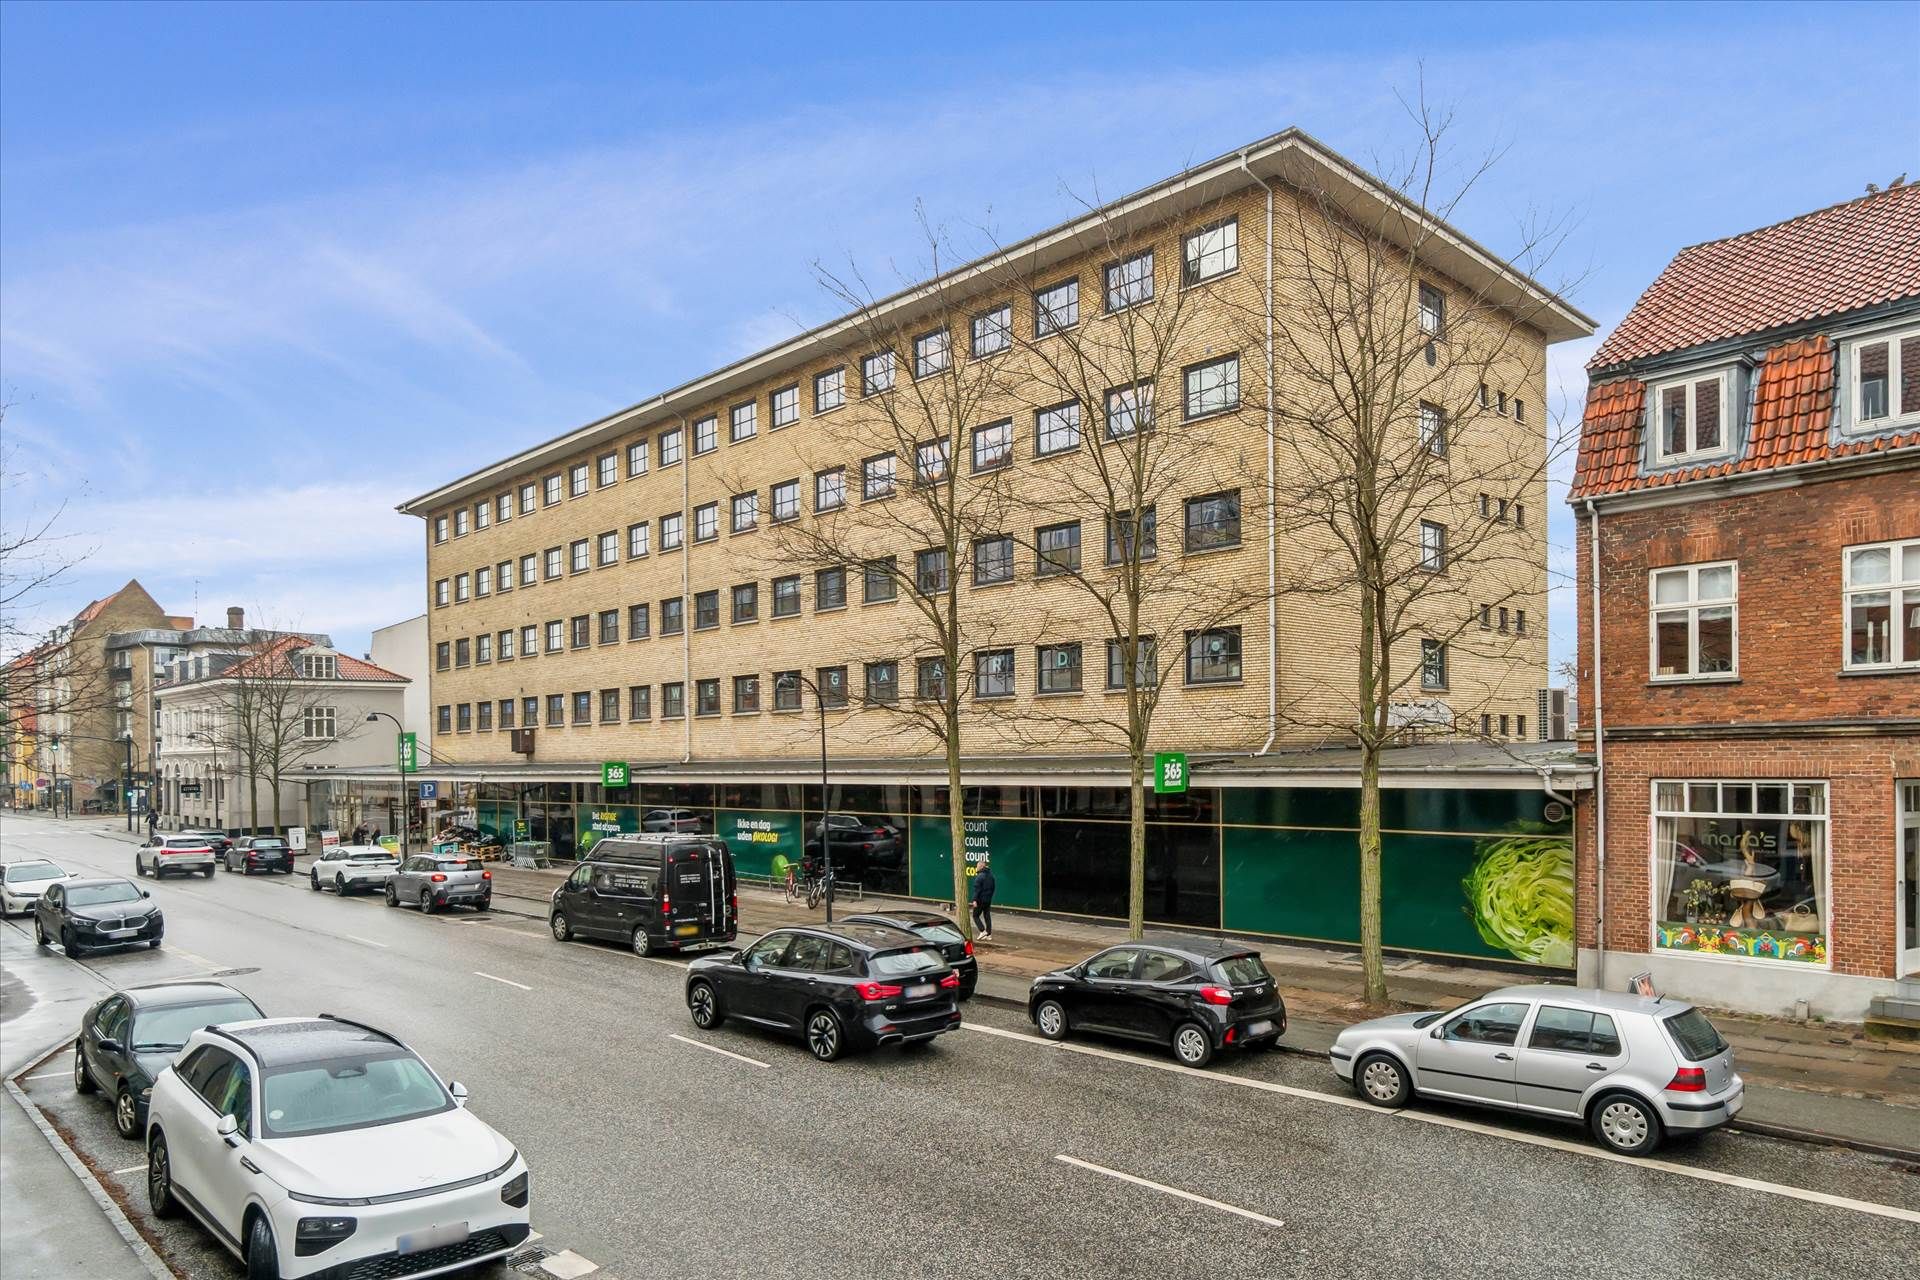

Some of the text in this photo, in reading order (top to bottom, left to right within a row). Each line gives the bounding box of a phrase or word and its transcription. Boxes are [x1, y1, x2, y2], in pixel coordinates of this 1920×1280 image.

[1057, 651, 1069, 667] D
[607, 767, 624, 779] 365
[1164, 762, 1182, 780] 365
[423, 783, 434, 797] P
[737, 818, 771, 832] Ikke en dag
[964, 820, 988, 833] count
[737, 831, 779, 843] uden ØKOLOGI
[964, 835, 989, 848] count
[1700, 831, 1778, 848] mara's
[965, 850, 990, 863] count
